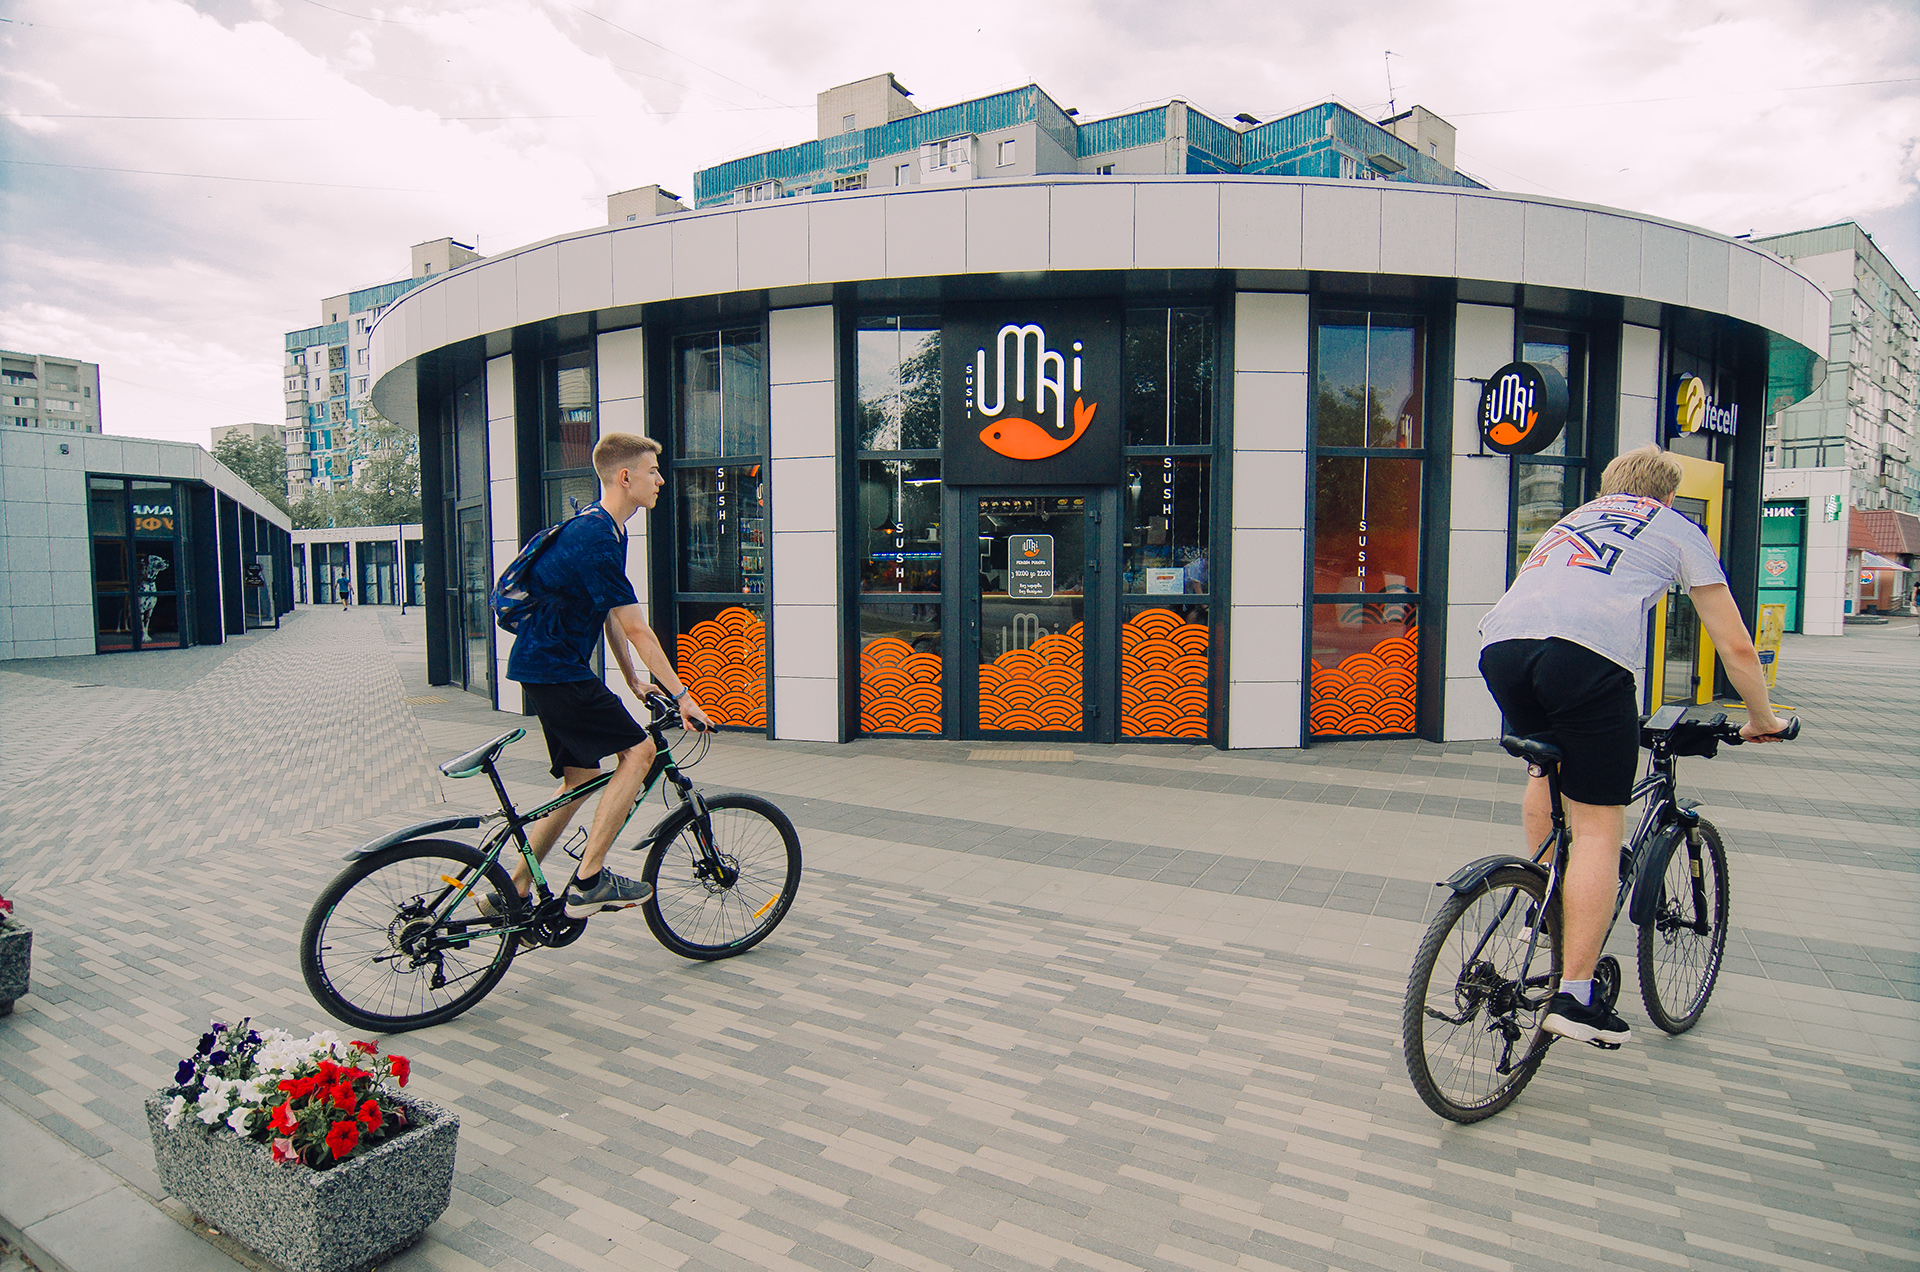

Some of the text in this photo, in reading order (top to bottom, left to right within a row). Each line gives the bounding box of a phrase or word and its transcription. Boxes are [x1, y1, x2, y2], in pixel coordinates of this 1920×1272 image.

[965, 364, 973, 419] SUSHI
[717, 467, 726, 534] SUSHI
[1163, 457, 1172, 530] SUSHI
[895, 523, 904, 593] SUSHI
[1357, 520, 1367, 592] SUSHI
